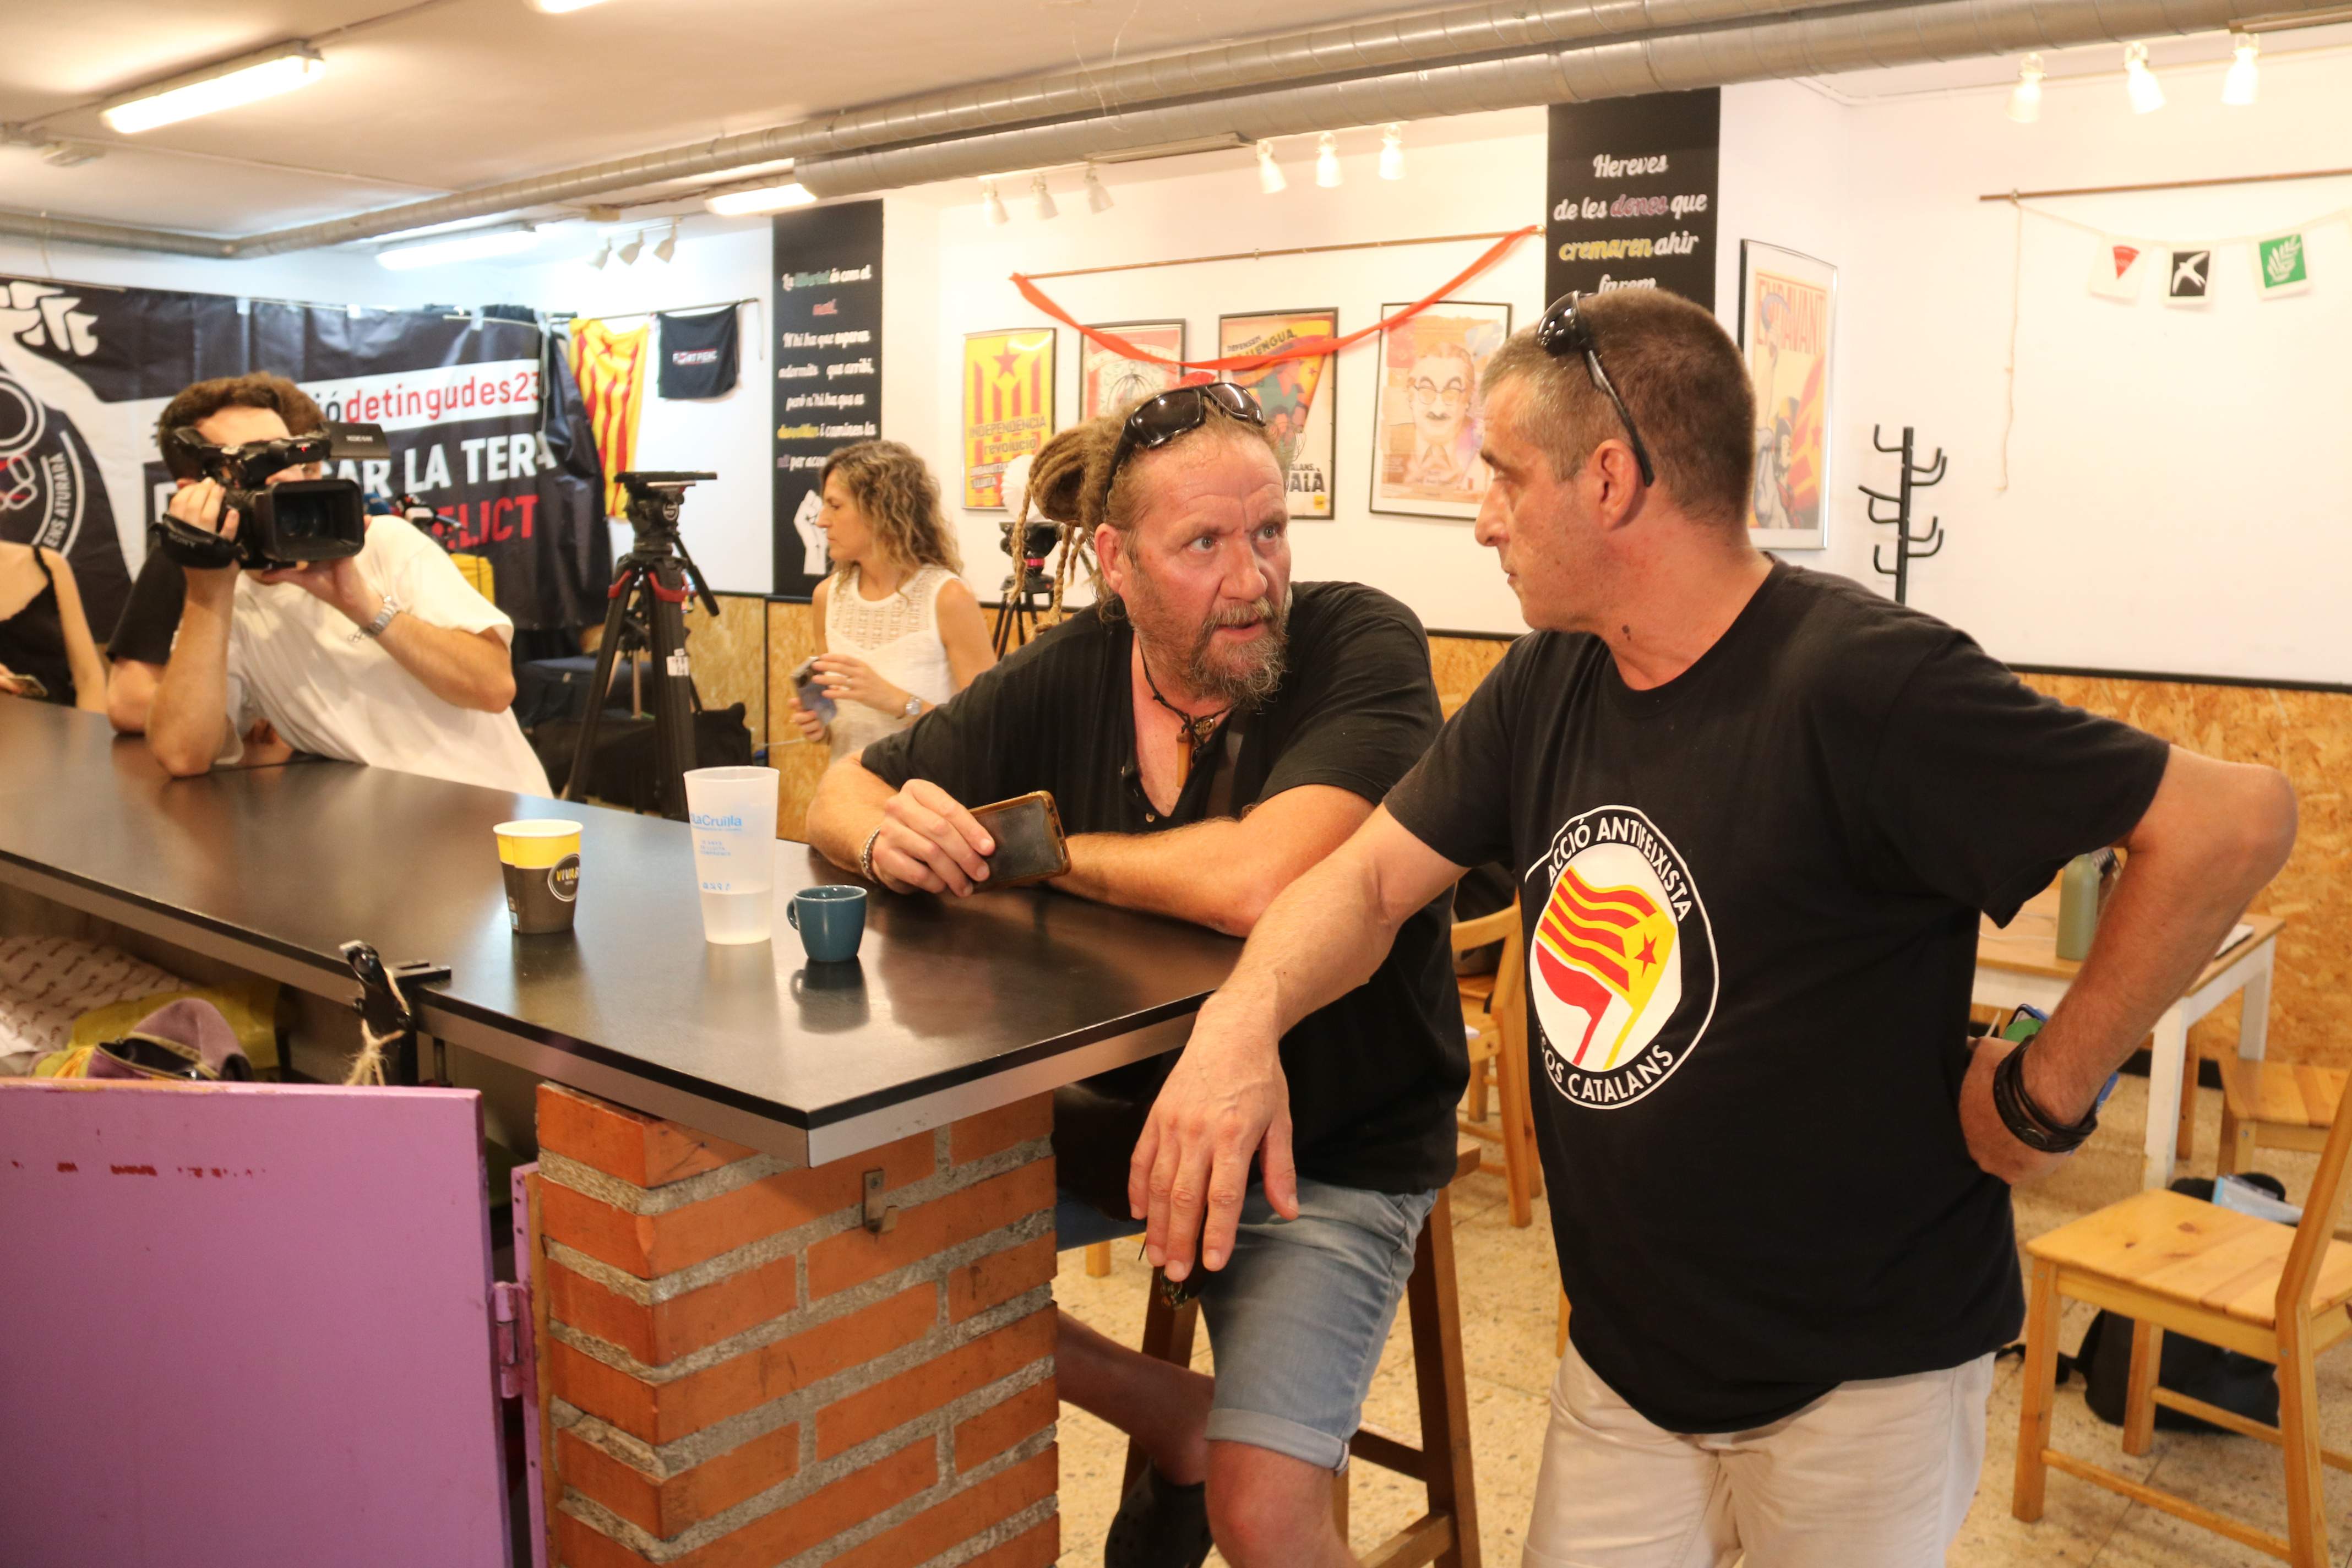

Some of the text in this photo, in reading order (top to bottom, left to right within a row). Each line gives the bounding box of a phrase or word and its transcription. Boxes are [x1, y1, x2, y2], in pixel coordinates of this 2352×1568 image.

[1593, 154, 1669, 178] Hereves
[1554, 193, 1708, 220] de les dones que
[1559, 230, 1700, 261] cremaren ahir
[404, 444, 452, 496] LA
[1547, 816, 1693, 922] ACCIÓ ANTIFEIXISTA
[1567, 1044, 1674, 1103] CATALANS
